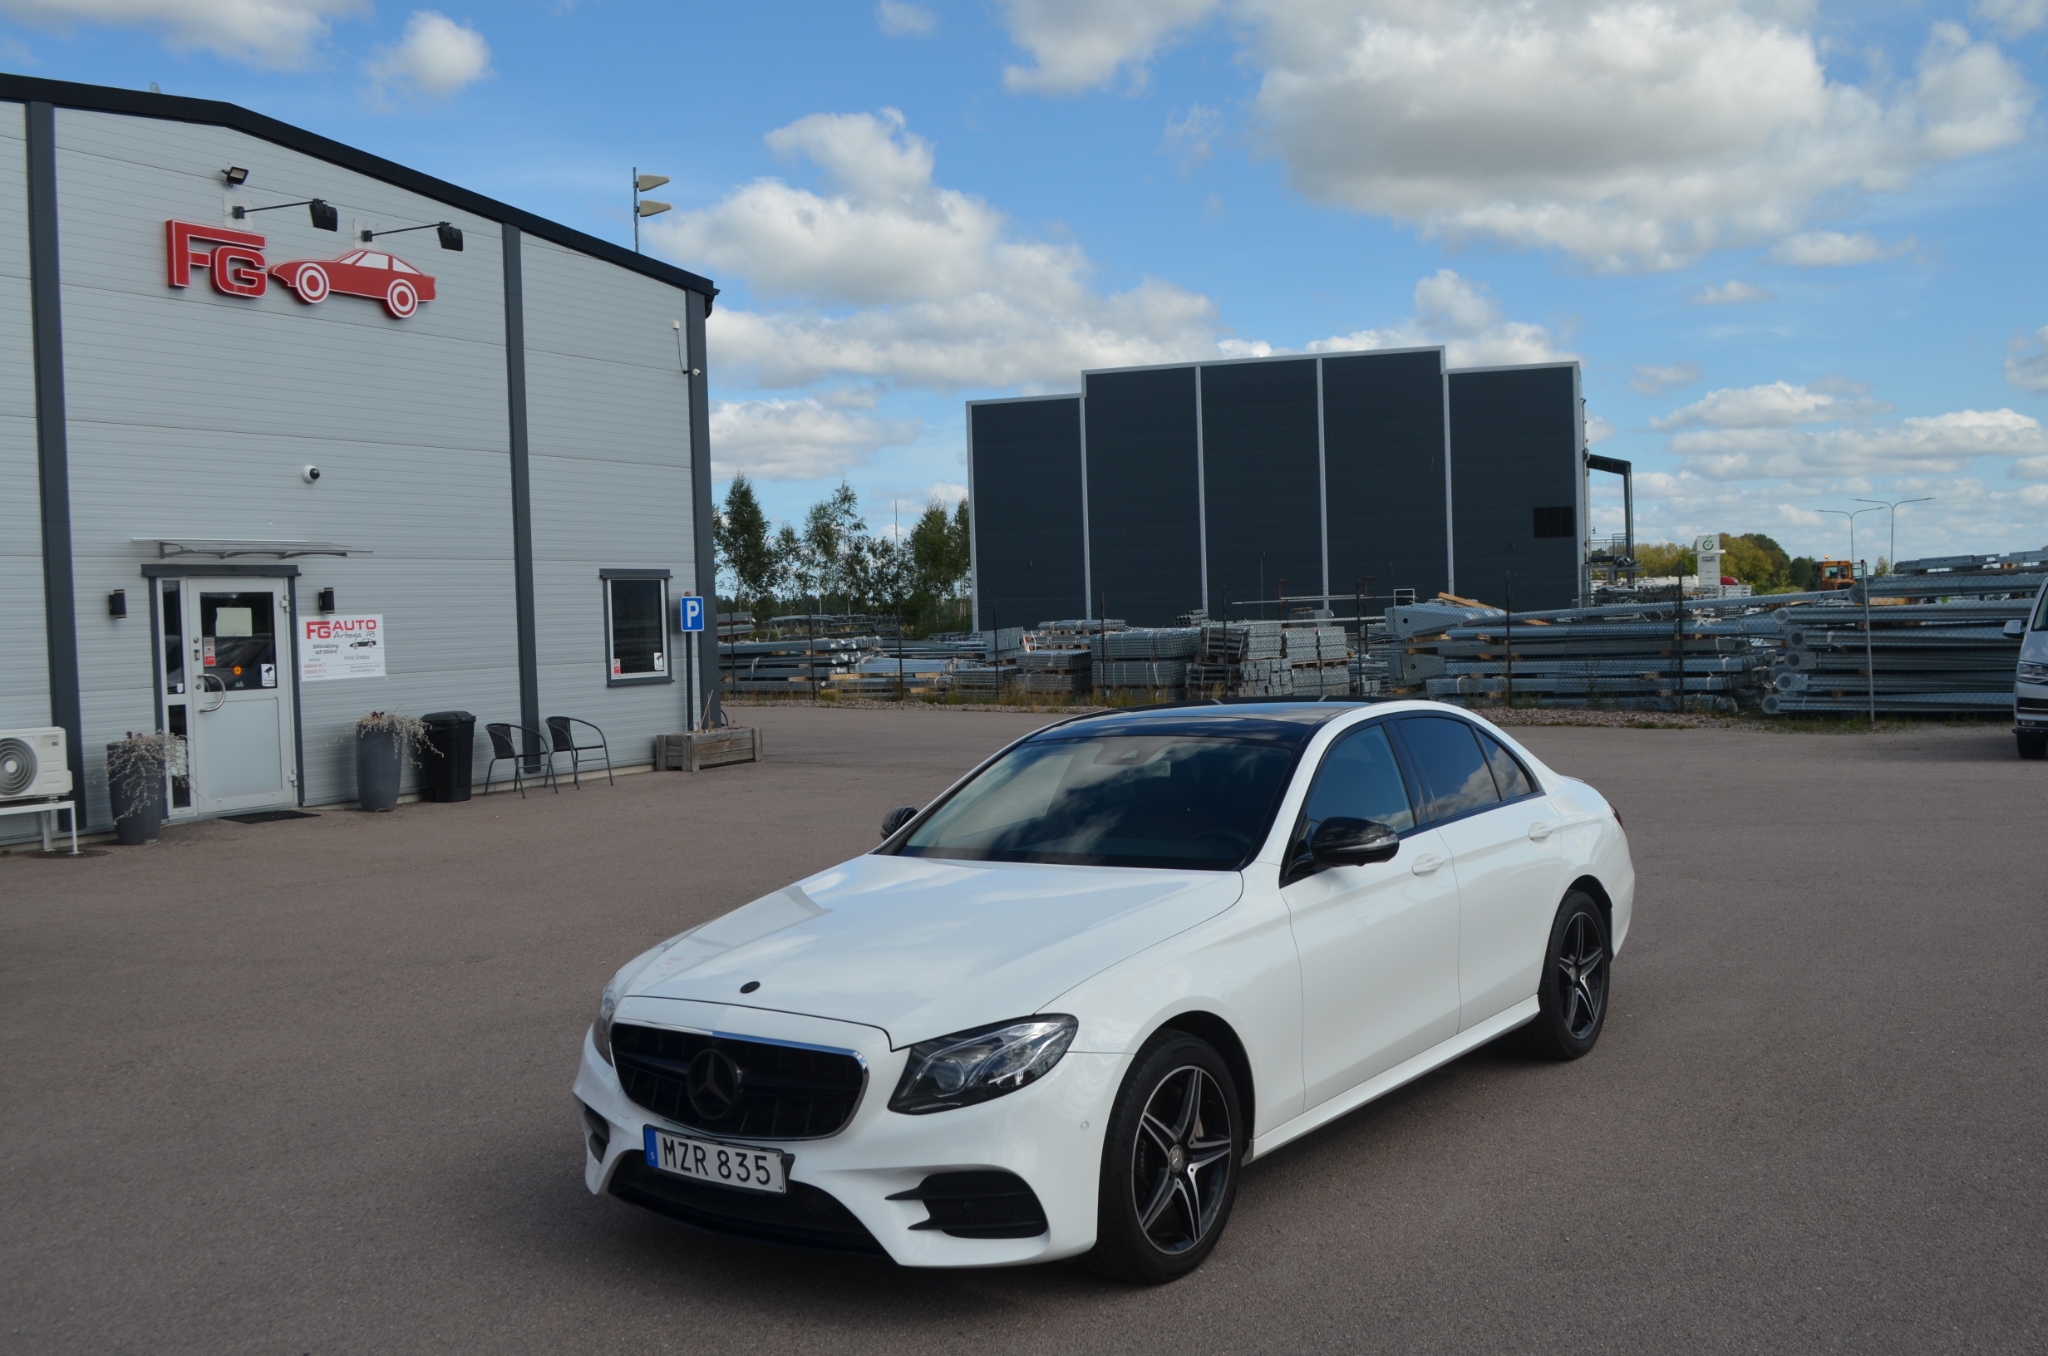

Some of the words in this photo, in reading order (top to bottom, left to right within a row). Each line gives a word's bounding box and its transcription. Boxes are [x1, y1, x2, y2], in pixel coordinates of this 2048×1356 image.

[166, 219, 267, 298] FG
[686, 600, 700, 628] P
[306, 621, 331, 639] FG
[332, 620, 377, 631] AUTO
[366, 630, 376, 638] AB
[662, 1137, 709, 1176] MZR
[716, 1149, 771, 1186] 835
